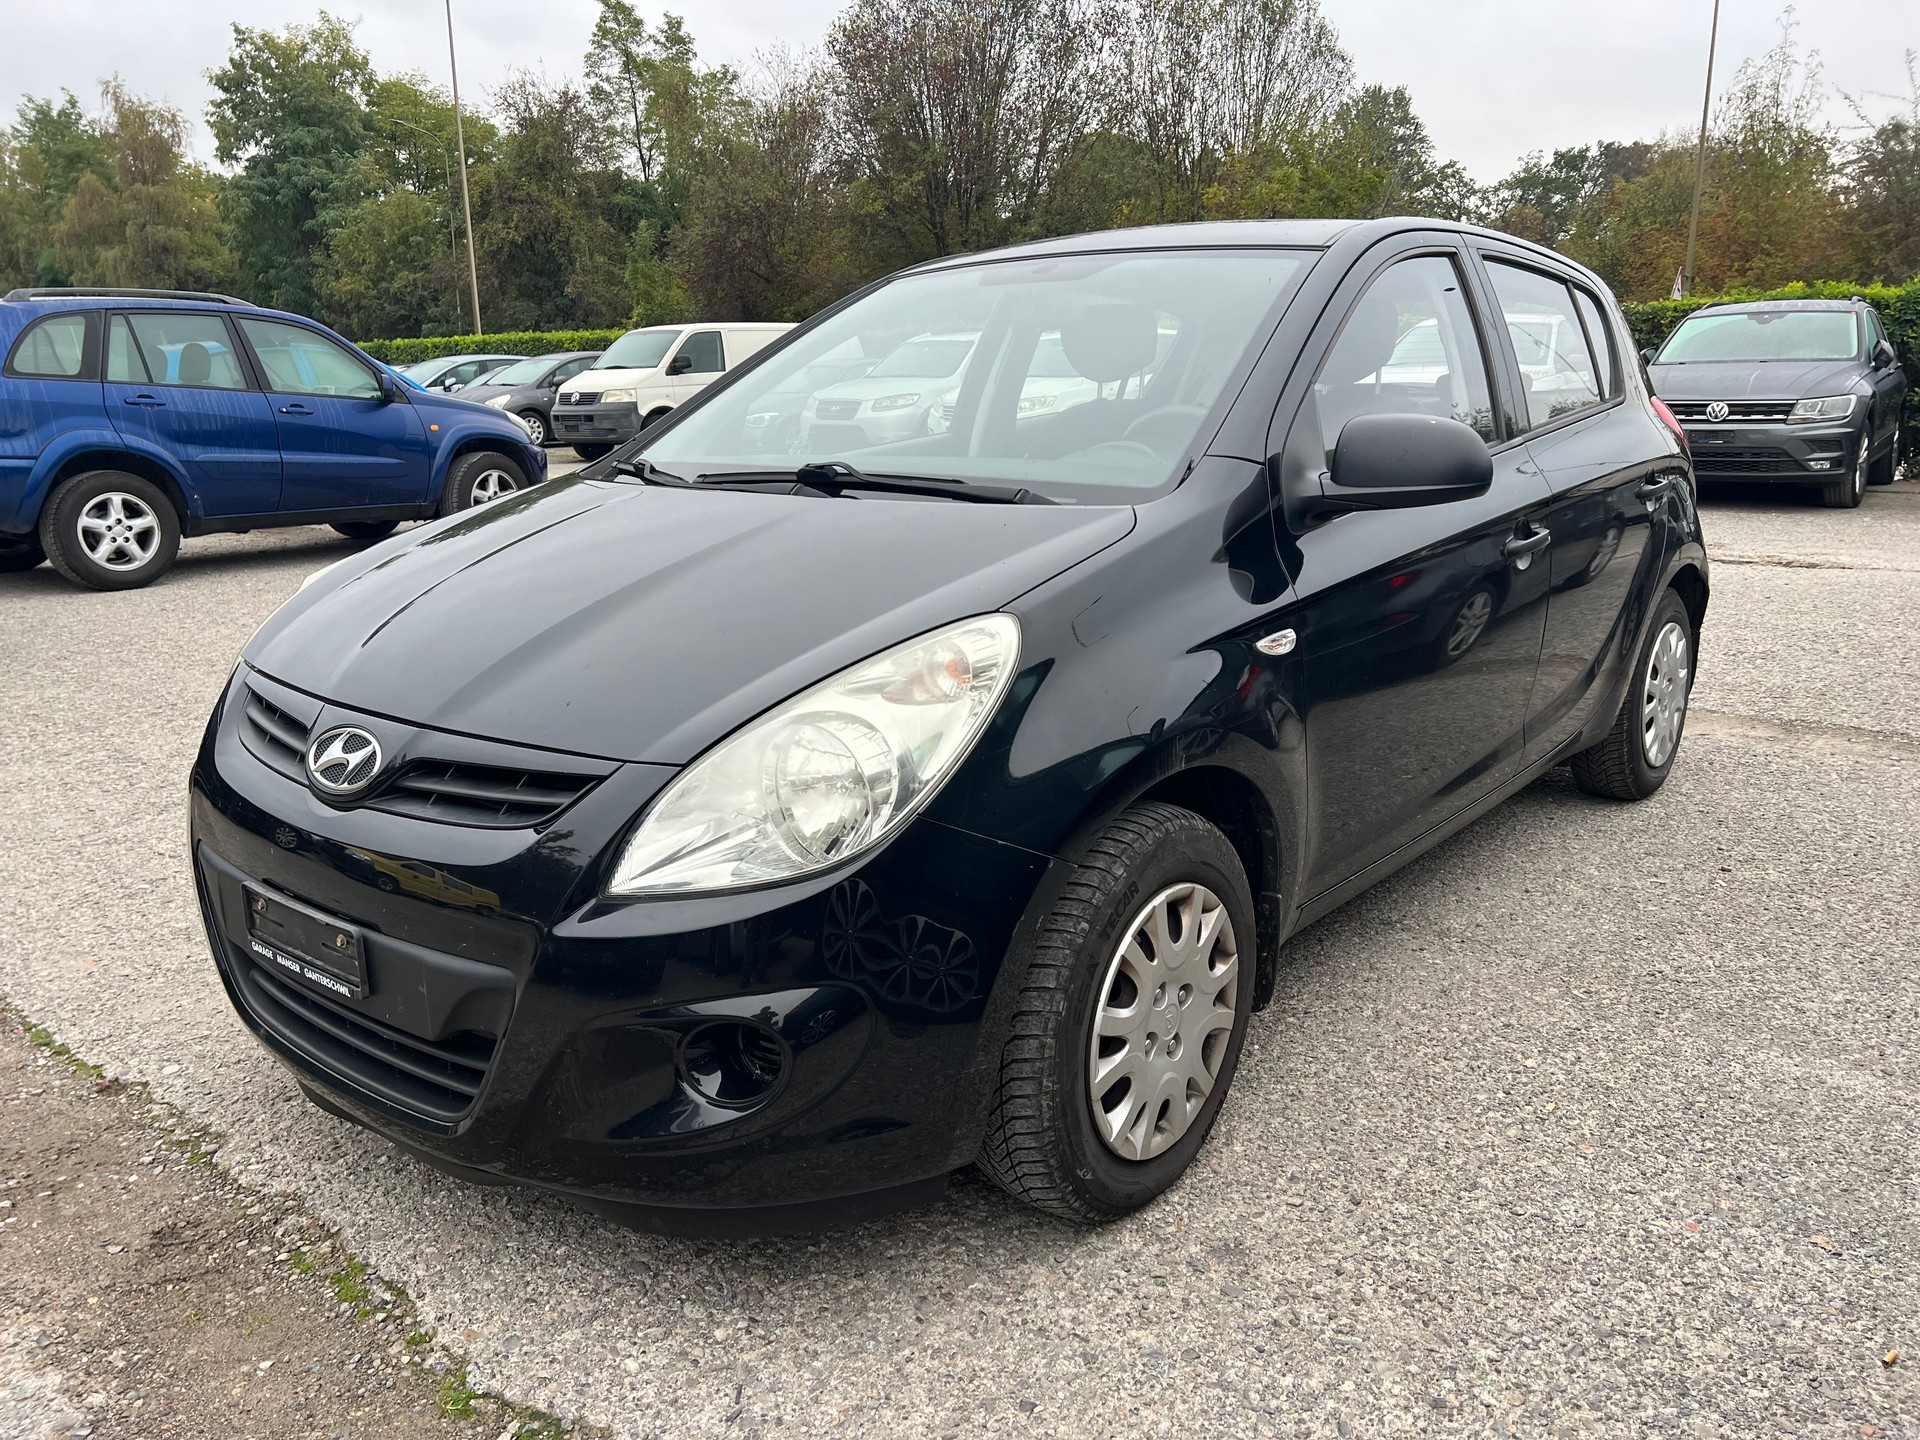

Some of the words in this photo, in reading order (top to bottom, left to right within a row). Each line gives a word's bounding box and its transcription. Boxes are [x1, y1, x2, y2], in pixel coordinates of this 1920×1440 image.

[1099, 880, 1140, 941] TECAR
[251, 941, 274, 960] GARAGE
[276, 954, 301, 974] MANSER
[303, 968, 351, 997] GANTERSCHWIL
